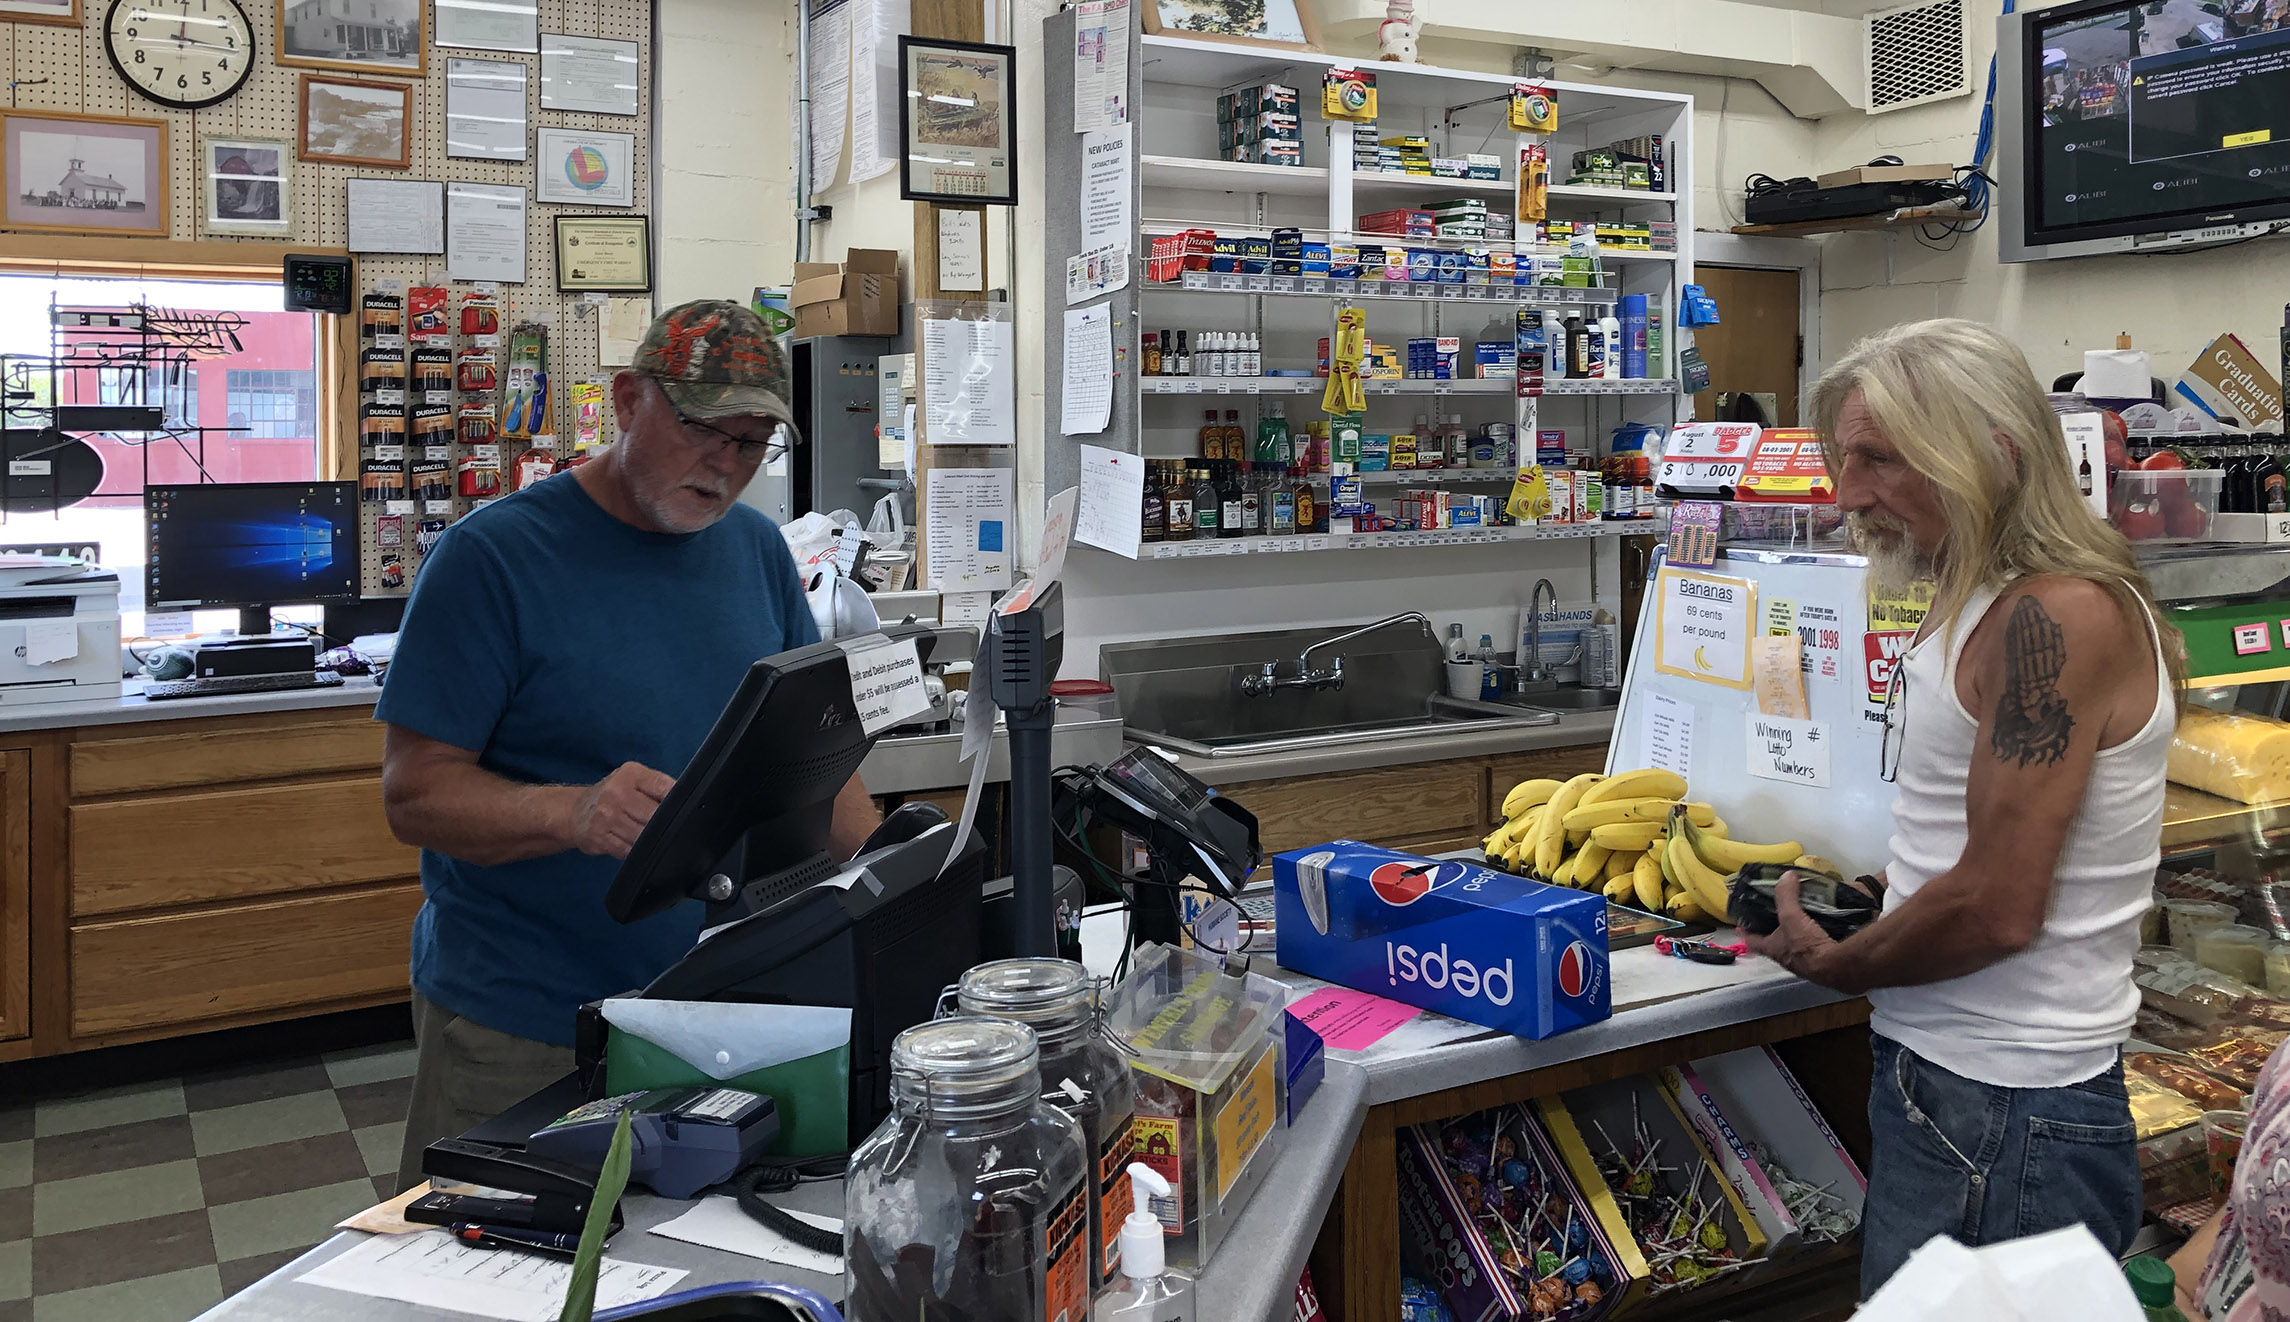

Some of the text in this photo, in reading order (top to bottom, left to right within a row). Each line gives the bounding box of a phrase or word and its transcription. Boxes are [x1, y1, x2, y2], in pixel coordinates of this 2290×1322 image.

[127, 28, 138, 42] 9
[2209, 44, 2236, 53] Warning
[134, 50, 146, 63] 8
[217, 58, 228, 70] 4
[2179, 65, 2209, 76] password
[2236, 55, 2258, 63] Please
[153, 67, 164, 81] 7
[202, 71, 211, 85] 5
[2147, 78, 2176, 88] password
[2221, 63, 2256, 73] information
[2147, 86, 2169, 94] change
[2185, 77, 2214, 87] password
[2257, 64, 2285, 73] continue
[177, 75, 187, 88] 6
[2147, 92, 2168, 100] current
[2169, 86, 2199, 97] password
[1088, 139, 1123, 155] NEW POLICIES
[1654, 173, 1662, 181] 22
[2205, 213, 2235, 222] Panasonic
[1187, 237, 1215, 247] TYLENOL
[1213, 244, 1236, 253] Advil
[1248, 245, 1267, 253] Advil
[1305, 251, 1327, 259] ALEVE
[1362, 254, 1384, 262] Zantac
[366, 301, 398, 309] DURACELL
[2219, 378, 2259, 420] Cards
[415, 407, 449, 417] DURACELL
[1681, 431, 1704, 439] August
[1712, 427, 1753, 436] BADGER
[1685, 435, 1739, 454] 2 5
[413, 463, 446, 472] DURACELL
[1664, 463, 1674, 476] $
[1680, 579, 1733, 600] Bananas
[1559, 610, 1593, 620] HANDS
[1687, 605, 1723, 621] 69 cents
[1812, 613, 1825, 621] TODAY'S
[1872, 604, 1926, 623] No Tobacc
[1683, 625, 1726, 640] per pound
[1798, 626, 1839, 650] 2001 1998
[862, 657, 915, 679] and Debit purchases
[867, 675, 919, 699] $5 will be assessed a
[1655, 695, 1665, 703] Dairy
[865, 705, 890, 720] cents fee.
[1755, 722, 1820, 748] Winning #
[1767, 740, 1786, 756] Lotto
[1774, 757, 1816, 779] Numbers
[1462, 868, 1500, 891] peps
[1595, 916, 1607, 935] 12
[1386, 941, 1514, 1006] pepsi
[1588, 963, 1604, 1006] pepsi
[1149, 1122, 1174, 1130] Farm
[1700, 1093, 1749, 1160] CHARMS
[1104, 1132, 1134, 1174] KICKAS
[1139, 1155, 1168, 1165] STICKS
[1400, 1142, 1477, 1287] Tootsie POPS
